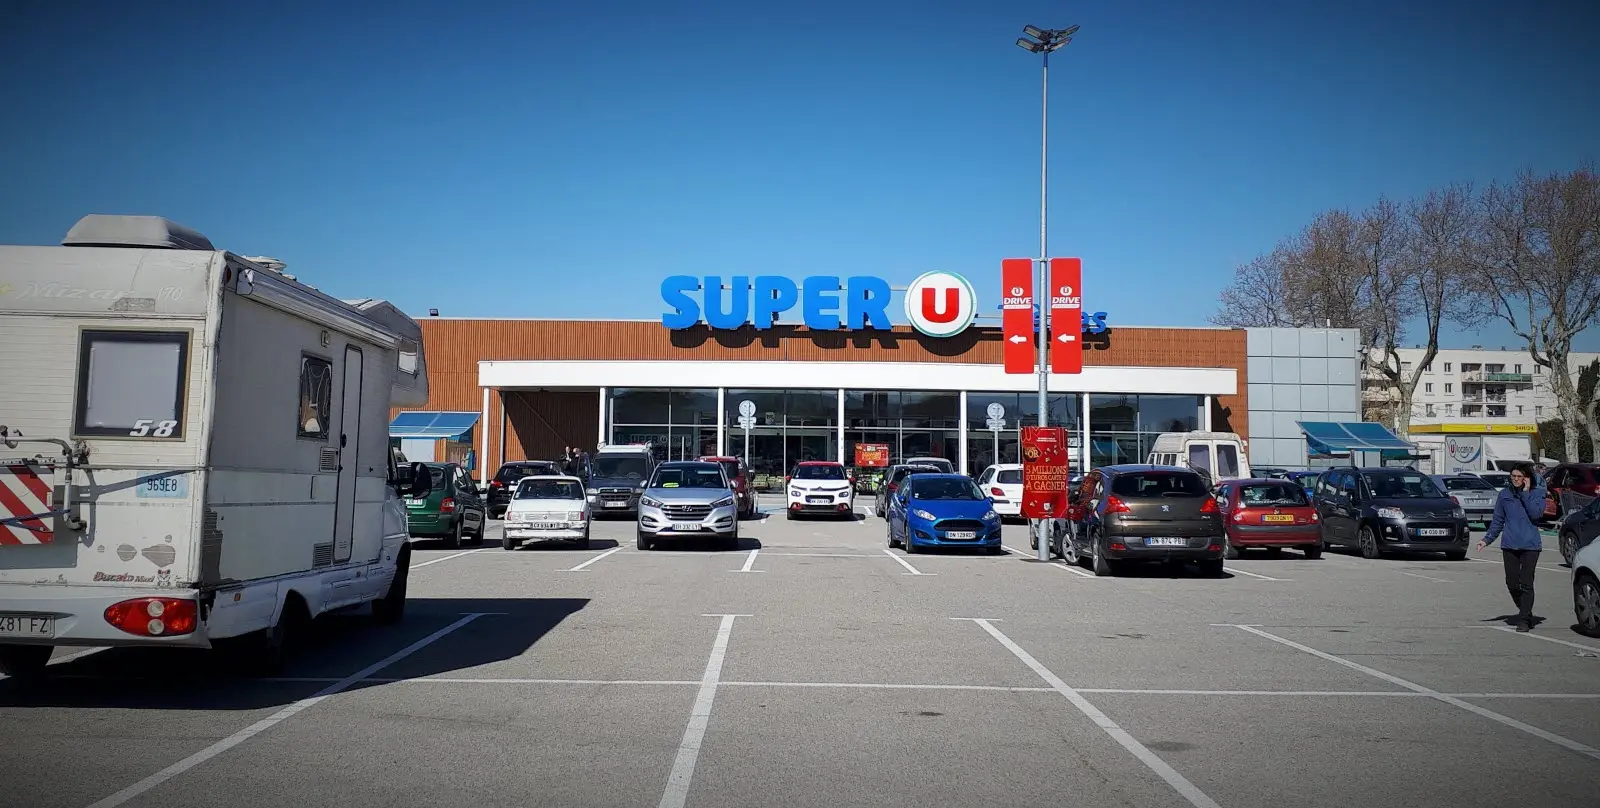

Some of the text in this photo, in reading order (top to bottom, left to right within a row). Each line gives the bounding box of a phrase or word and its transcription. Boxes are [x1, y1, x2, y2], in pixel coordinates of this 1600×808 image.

[660, 275, 893, 330] SUPER
[921, 287, 960, 324] U
[1003, 297, 1032, 305] DRIVE
[1052, 296, 1081, 304] DRIVE
[129, 419, 178, 437] 58
[1032, 465, 1067, 475] MILLIONS
[147, 479, 178, 492] 969E8
[1033, 481, 1066, 490] GAGNER
[93, 571, 134, 582] Ducato
[30, 618, 48, 633] FZ
